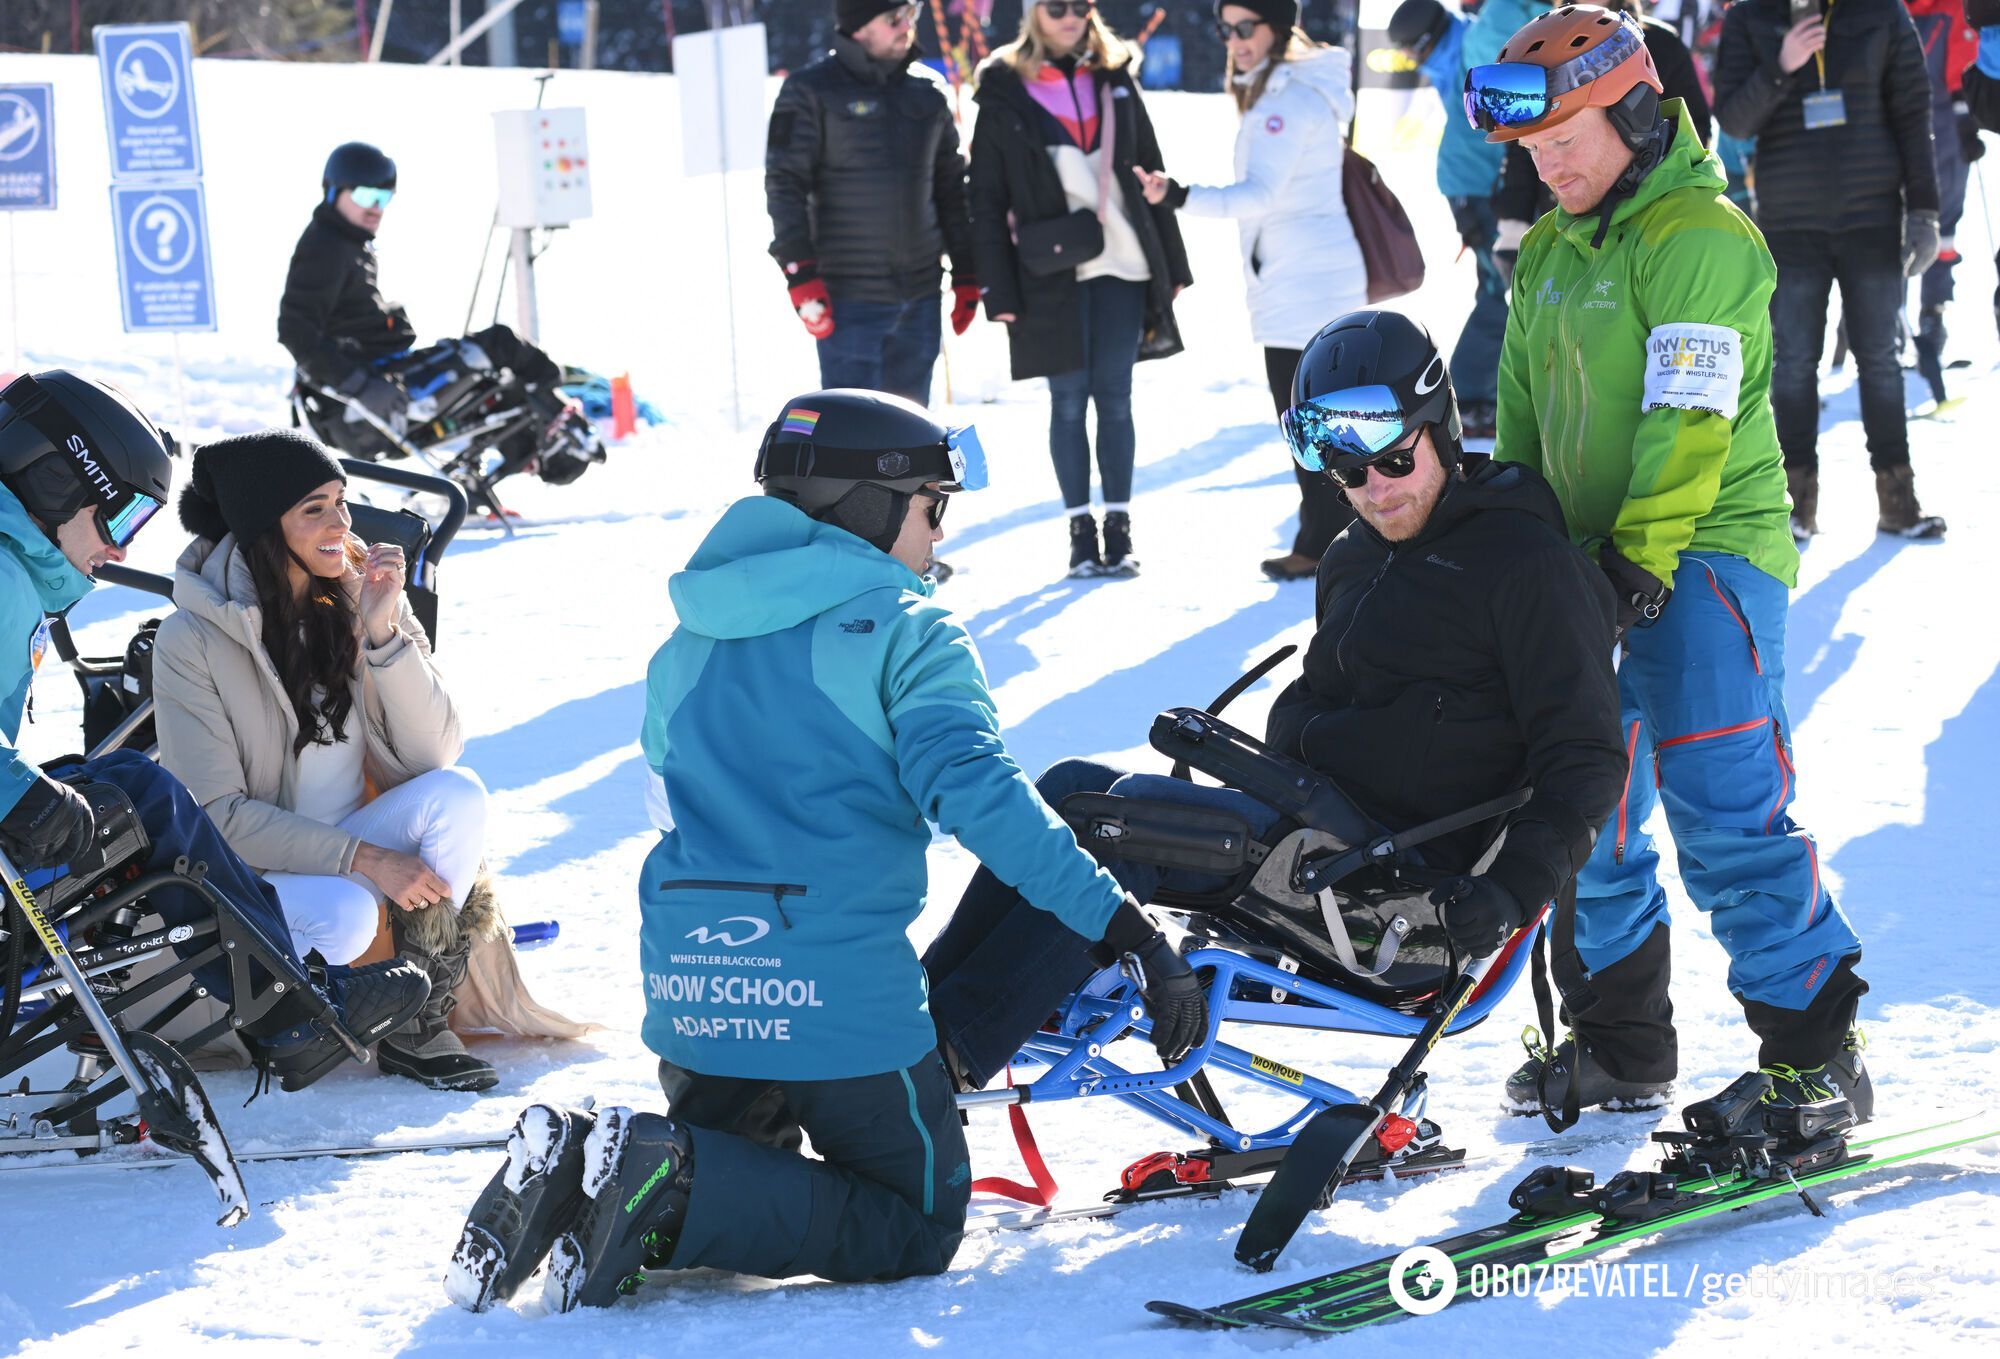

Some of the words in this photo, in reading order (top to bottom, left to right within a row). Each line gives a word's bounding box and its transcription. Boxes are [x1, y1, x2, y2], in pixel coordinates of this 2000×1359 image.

[1653, 337, 1731, 355] INVICTUS
[1659, 352, 1717, 369] GAMES
[1685, 369, 1717, 379] WHISTLER
[66, 434, 119, 500] SMITH
[16, 881, 64, 954] SUPERLITE
[649, 972, 706, 1002] SNOW
[710, 975, 823, 1007] SCHOOL
[672, 1015, 791, 1041] ADAPTIVE
[1253, 1056, 1302, 1082] MONIQUE
[624, 1157, 670, 1213] NORDICA
